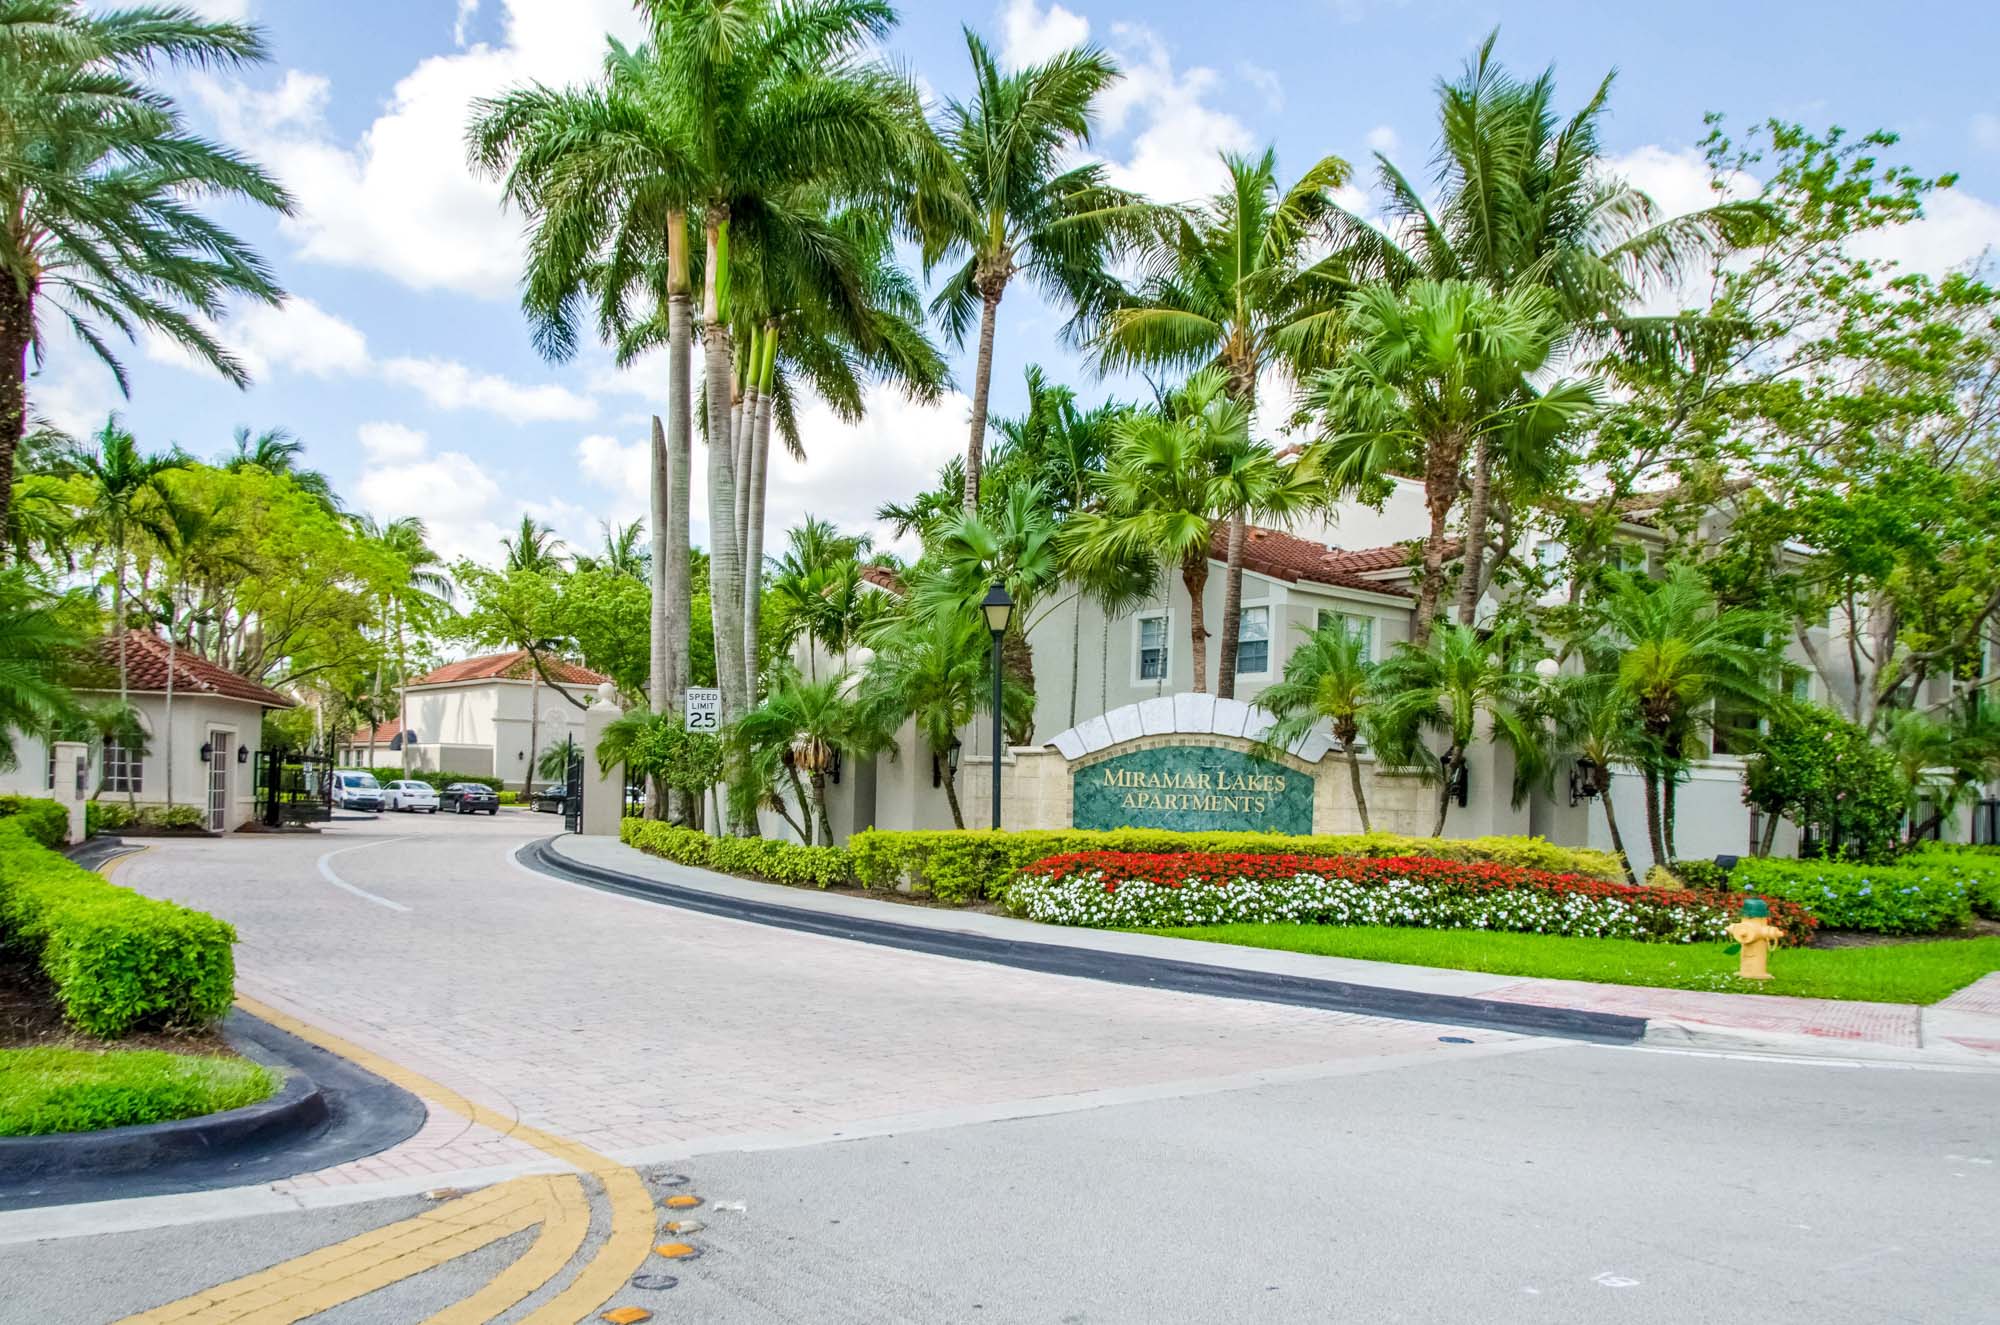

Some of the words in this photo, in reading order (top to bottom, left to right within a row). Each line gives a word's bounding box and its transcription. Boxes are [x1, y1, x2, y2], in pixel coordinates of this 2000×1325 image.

[690, 712, 716, 728] 25
[1103, 768, 1212, 790] MIRAMAR
[1217, 771, 1286, 792] LAKES
[1121, 792, 1266, 813] APARTMENTS
